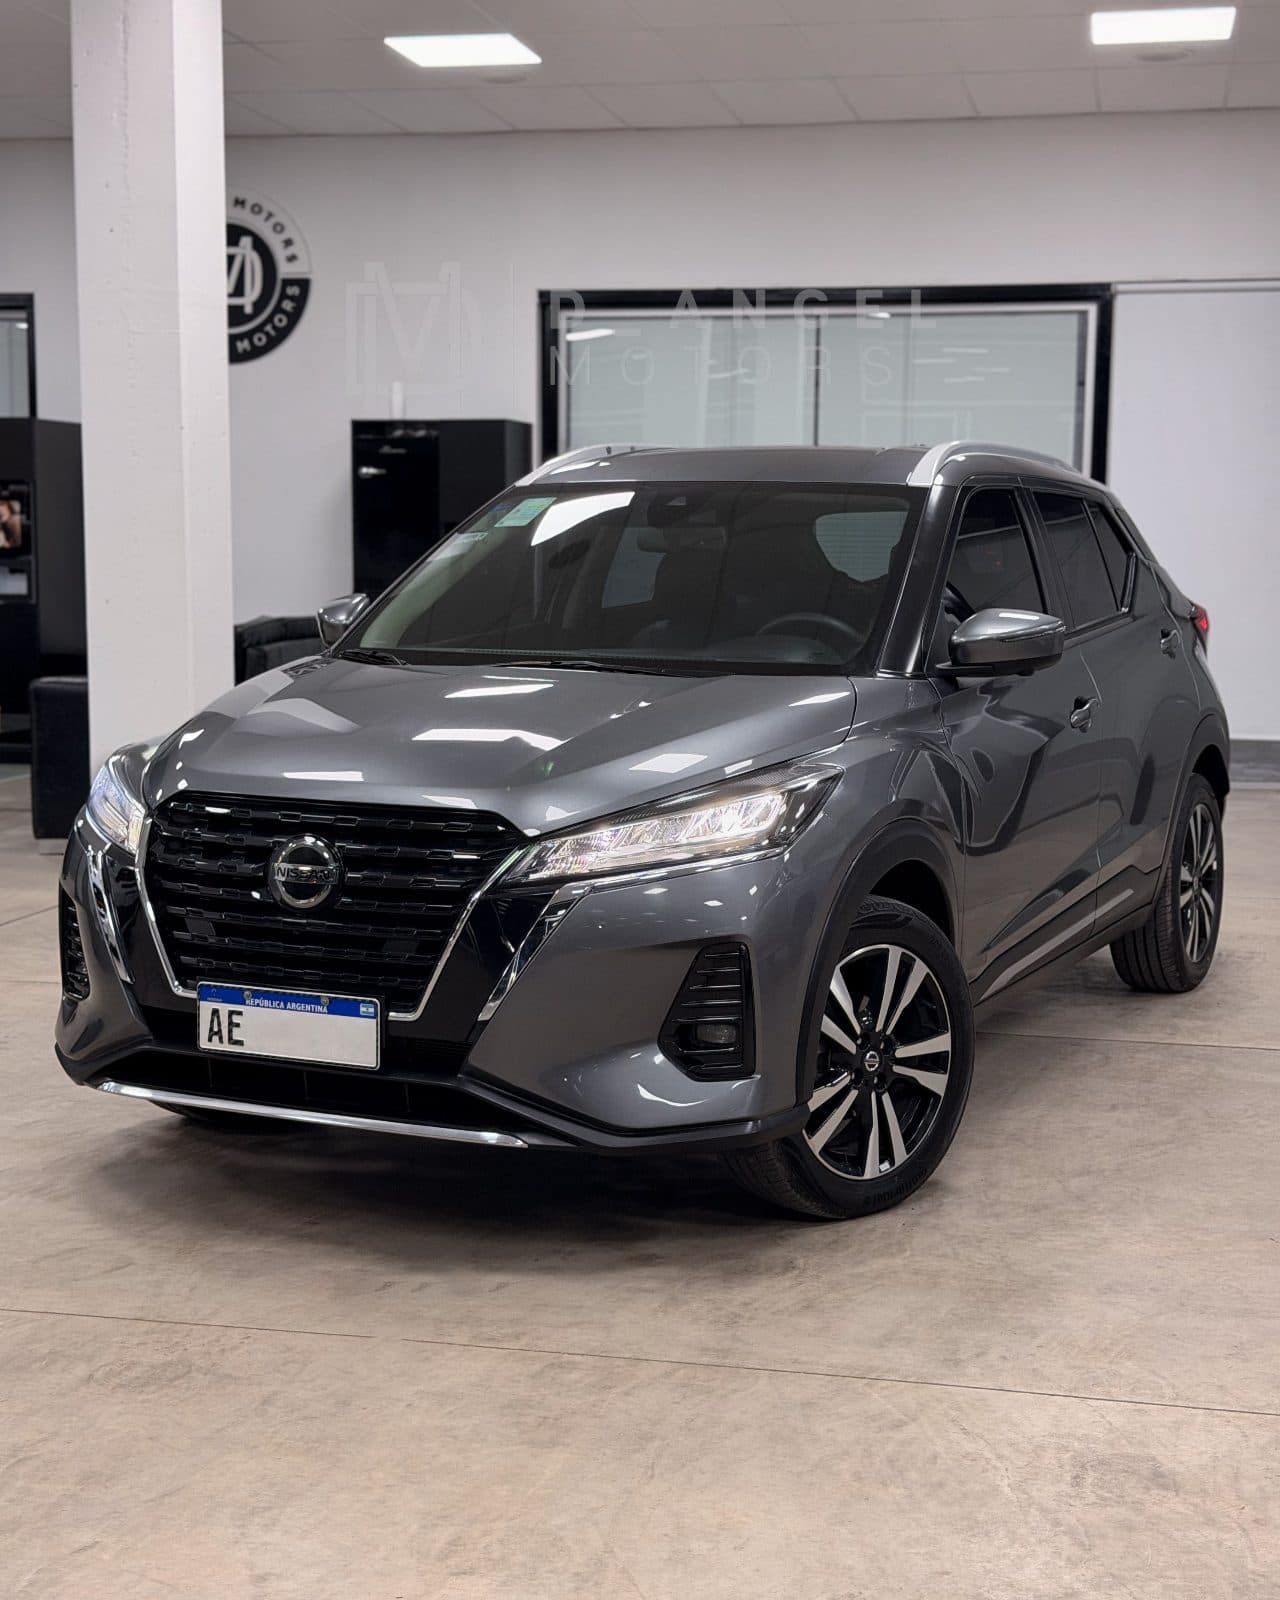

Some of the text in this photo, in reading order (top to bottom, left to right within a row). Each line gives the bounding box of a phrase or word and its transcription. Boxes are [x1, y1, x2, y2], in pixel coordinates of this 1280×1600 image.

[233, 196, 298, 263] MOTORS
[235, 285, 300, 354] MOTORS
[207, 1007, 245, 1047] AE
[245, 998, 328, 1014] REPÚBLICA ARGENTINA
